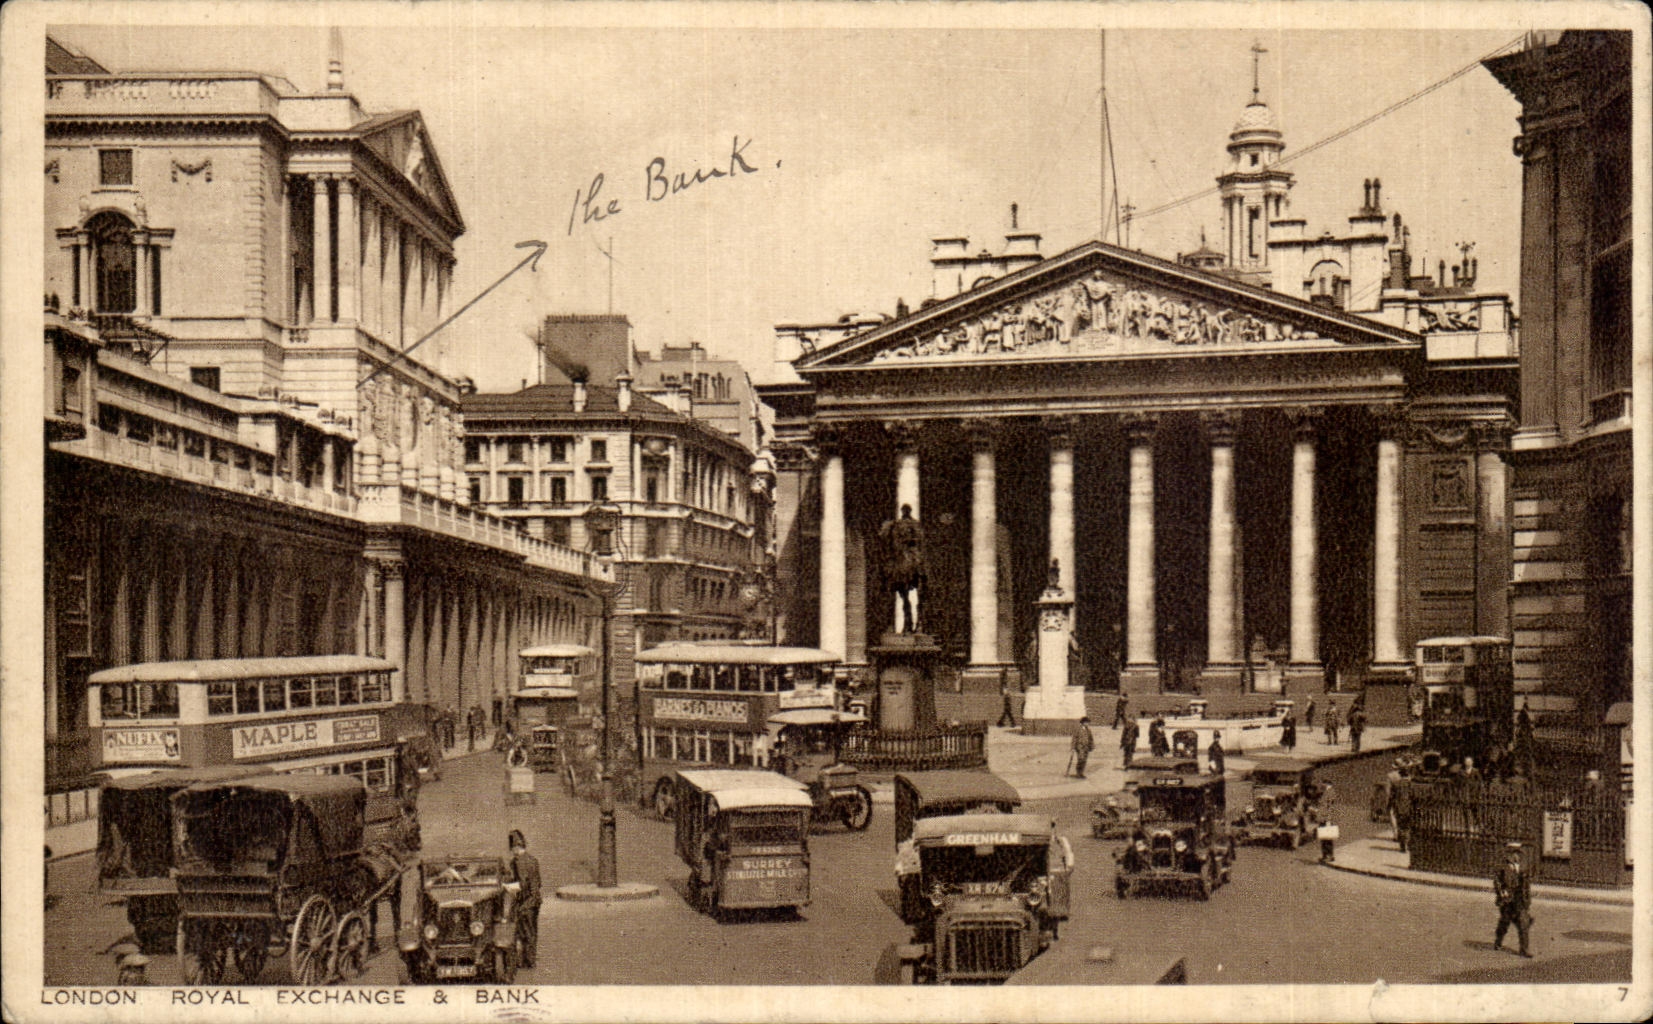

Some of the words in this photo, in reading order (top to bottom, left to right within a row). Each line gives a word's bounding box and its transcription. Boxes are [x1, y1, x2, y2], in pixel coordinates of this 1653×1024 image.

[240, 722, 318, 748] MAPLE
[946, 832, 1019, 845] GREENHAM
[742, 858, 793, 870] SURREY
